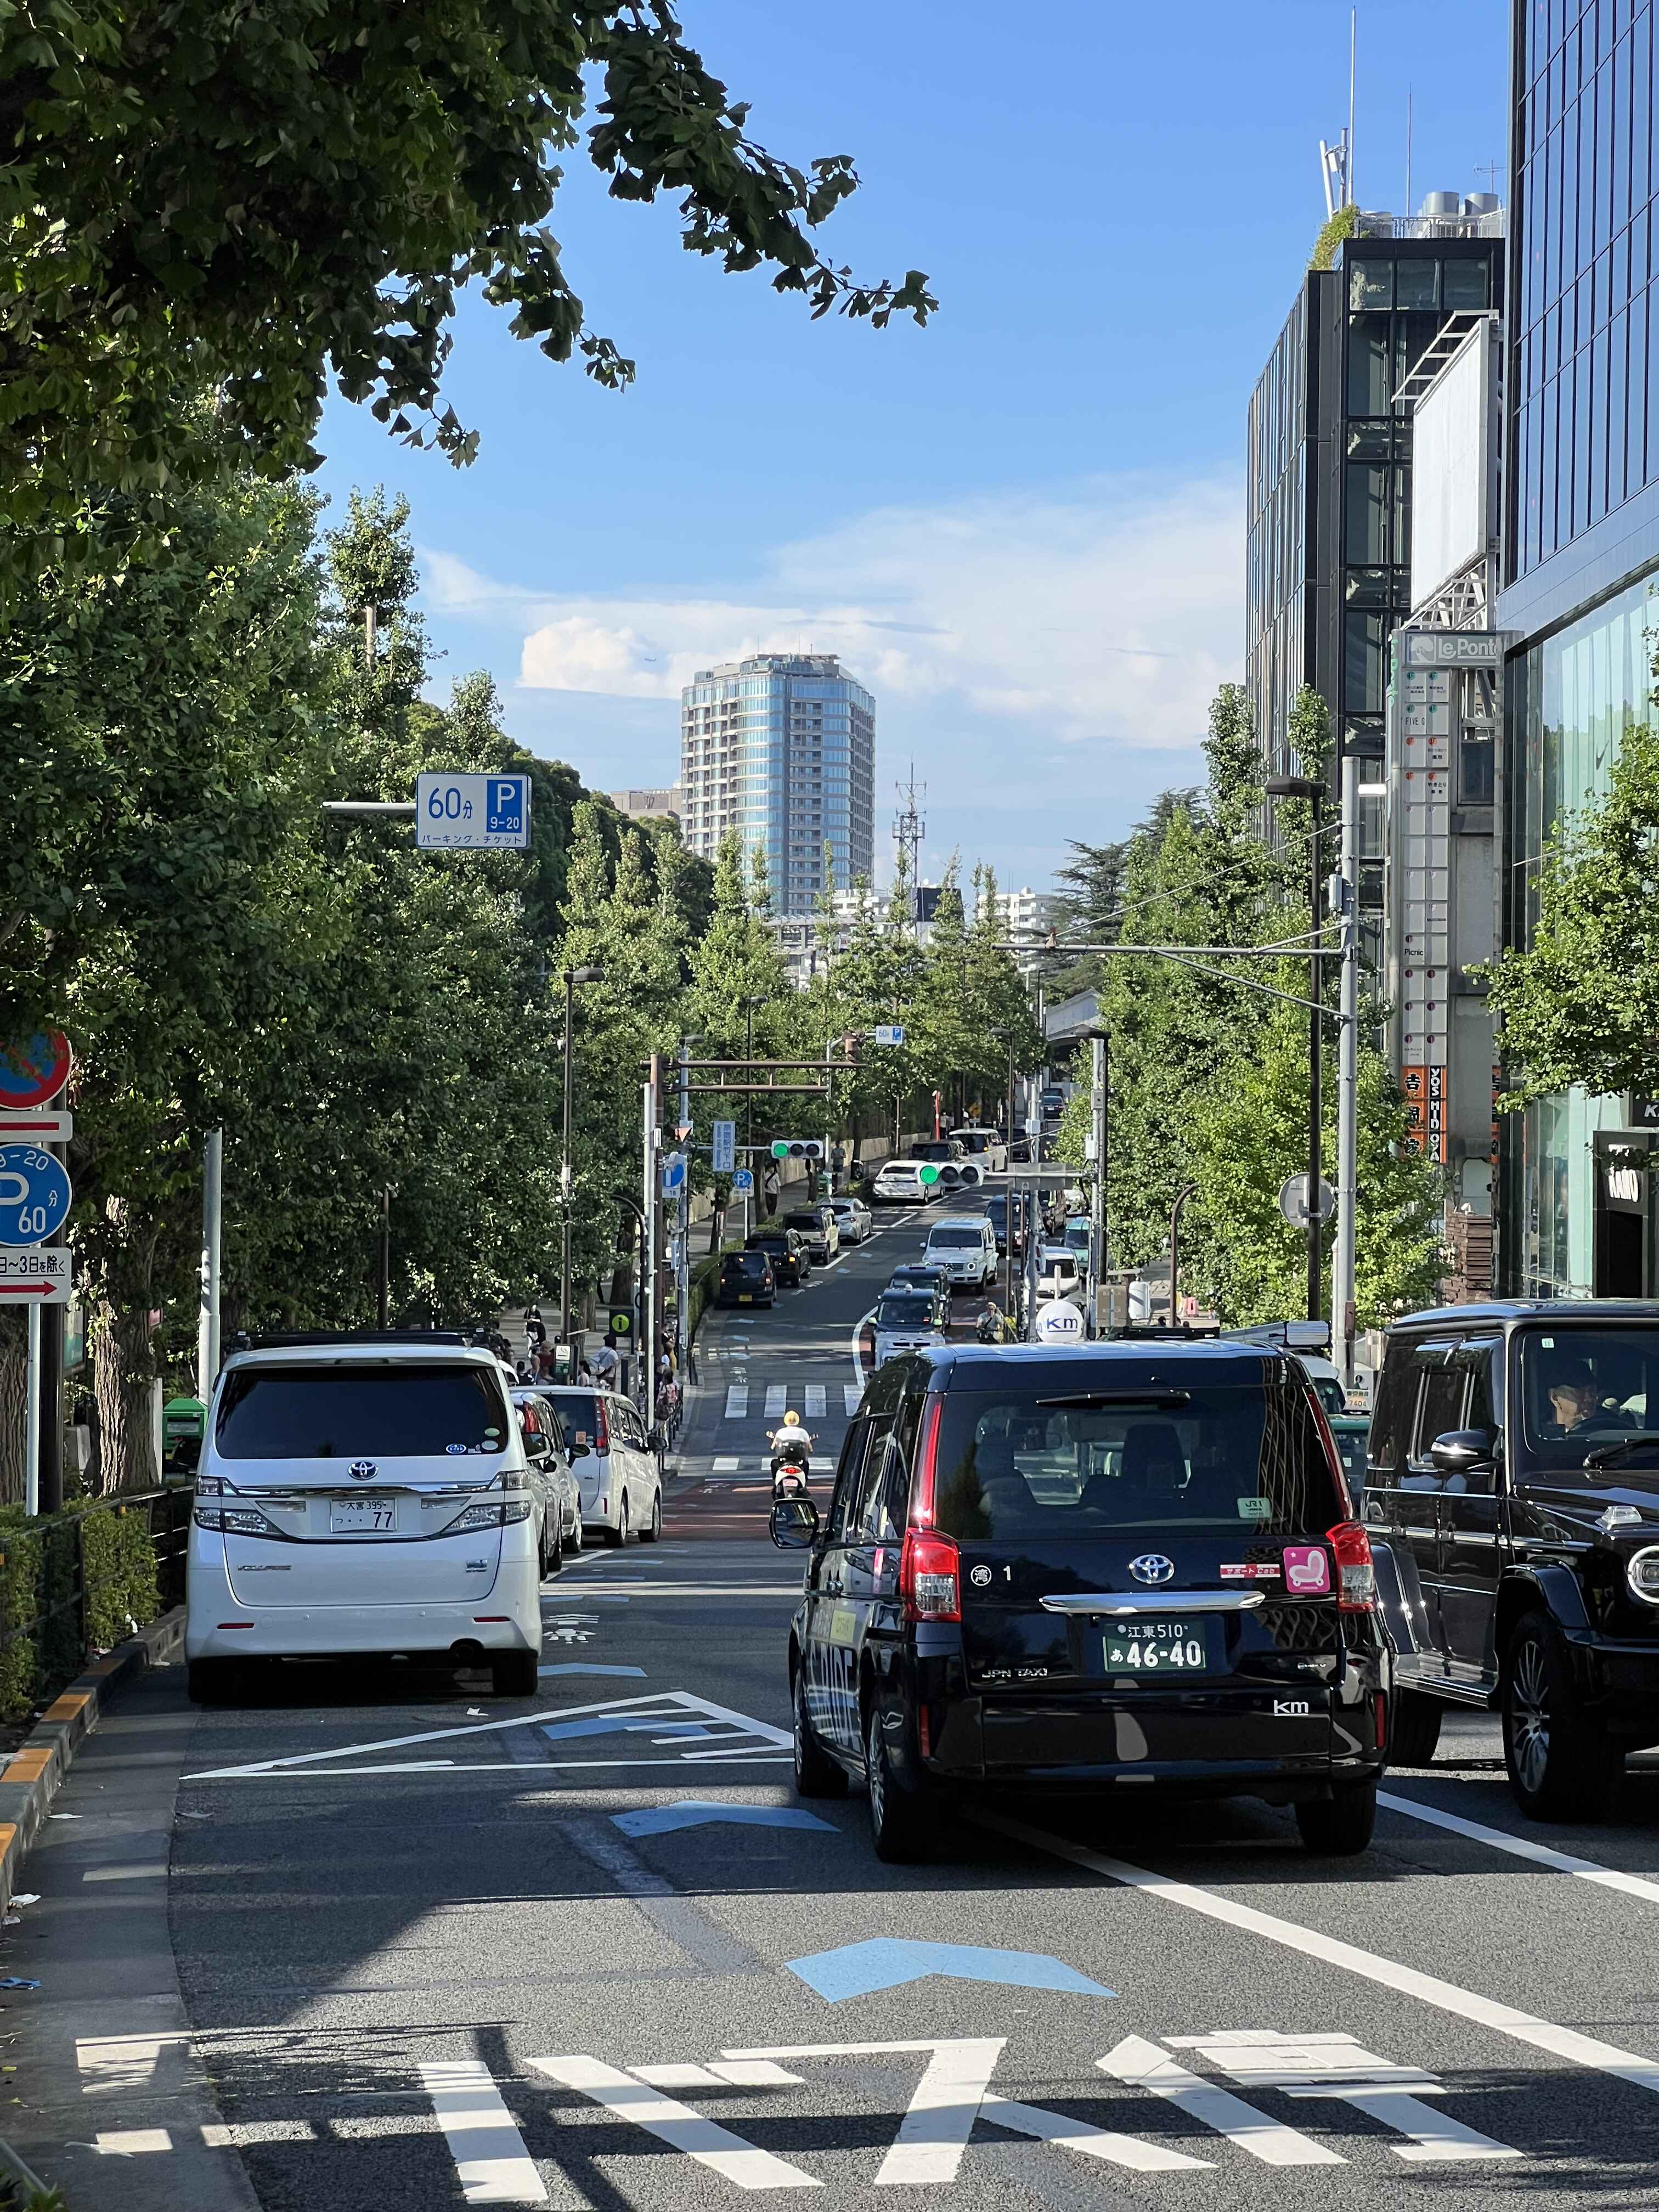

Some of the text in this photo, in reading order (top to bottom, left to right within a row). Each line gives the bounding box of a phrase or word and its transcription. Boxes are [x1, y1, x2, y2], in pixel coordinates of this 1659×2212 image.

[1457, 638, 1497, 656] Pont
[429, 788, 473, 819] 60分
[497, 783, 516, 813] P
[490, 816, 520, 830] 9-20
[737, 1173, 745, 1186] P
[346, 1500, 382, 1510] 大宮 395
[1127, 1624, 1183, 1638] 江東 510
[1110, 1640, 1201, 1668] あ 46-40
